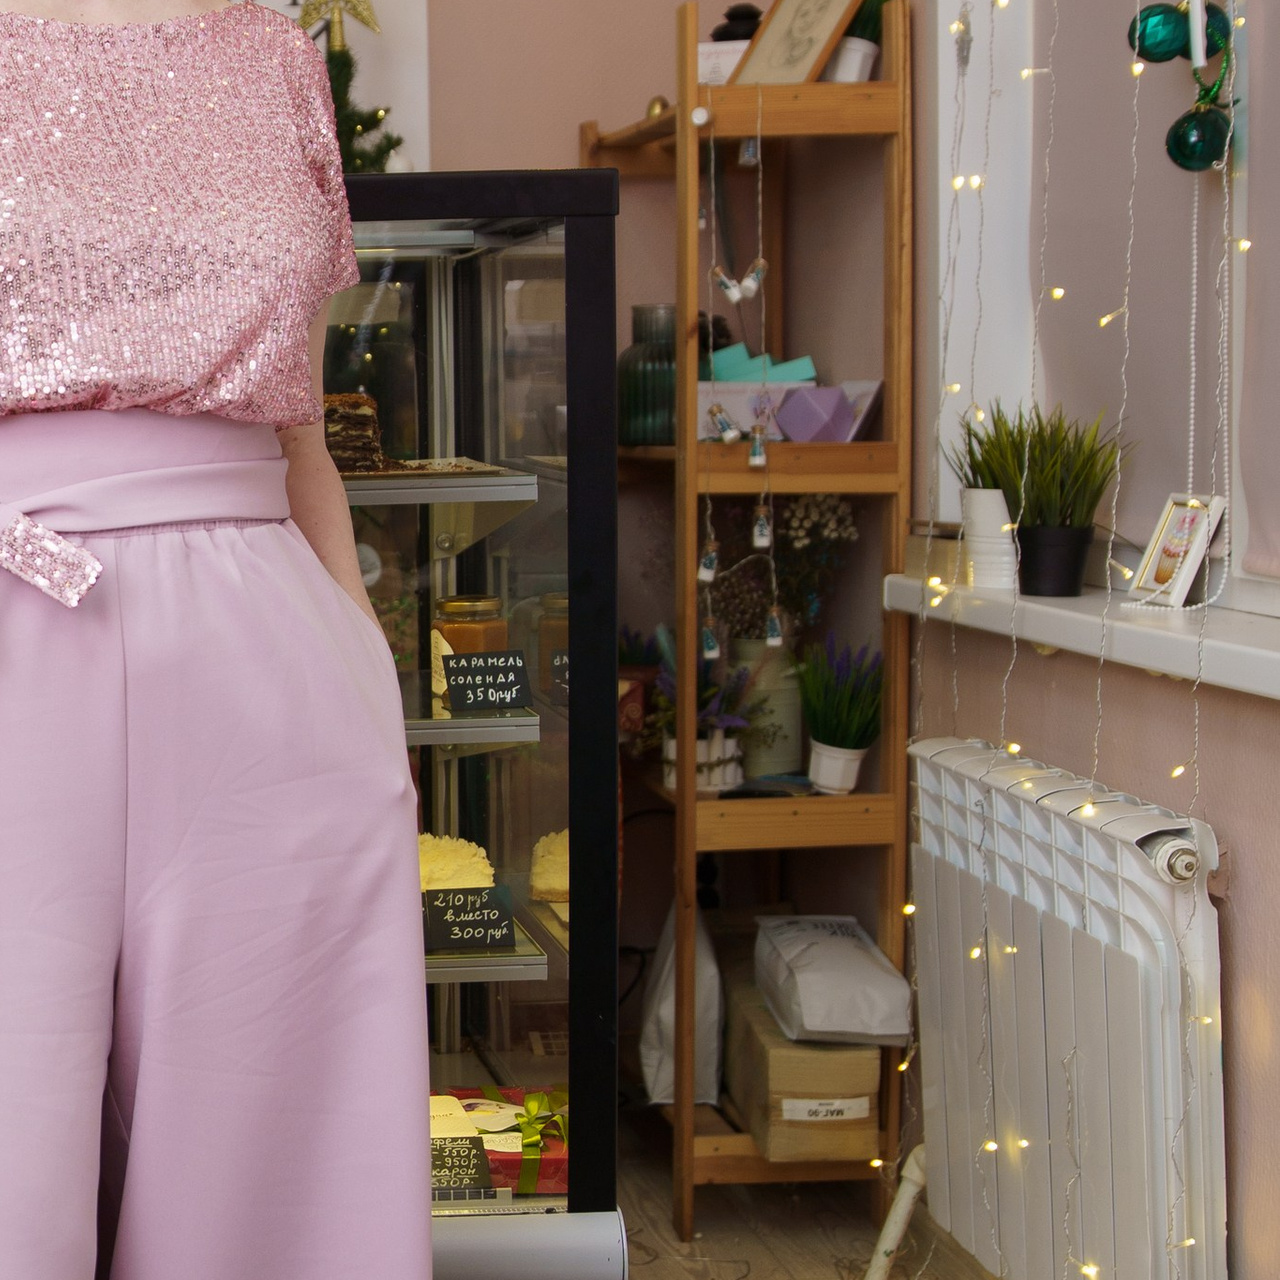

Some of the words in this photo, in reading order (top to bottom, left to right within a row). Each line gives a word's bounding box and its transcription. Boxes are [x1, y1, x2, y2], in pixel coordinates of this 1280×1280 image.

[433, 893, 464, 907] 210
[467, 889, 489, 911] руб
[450, 927, 485, 939] 300
